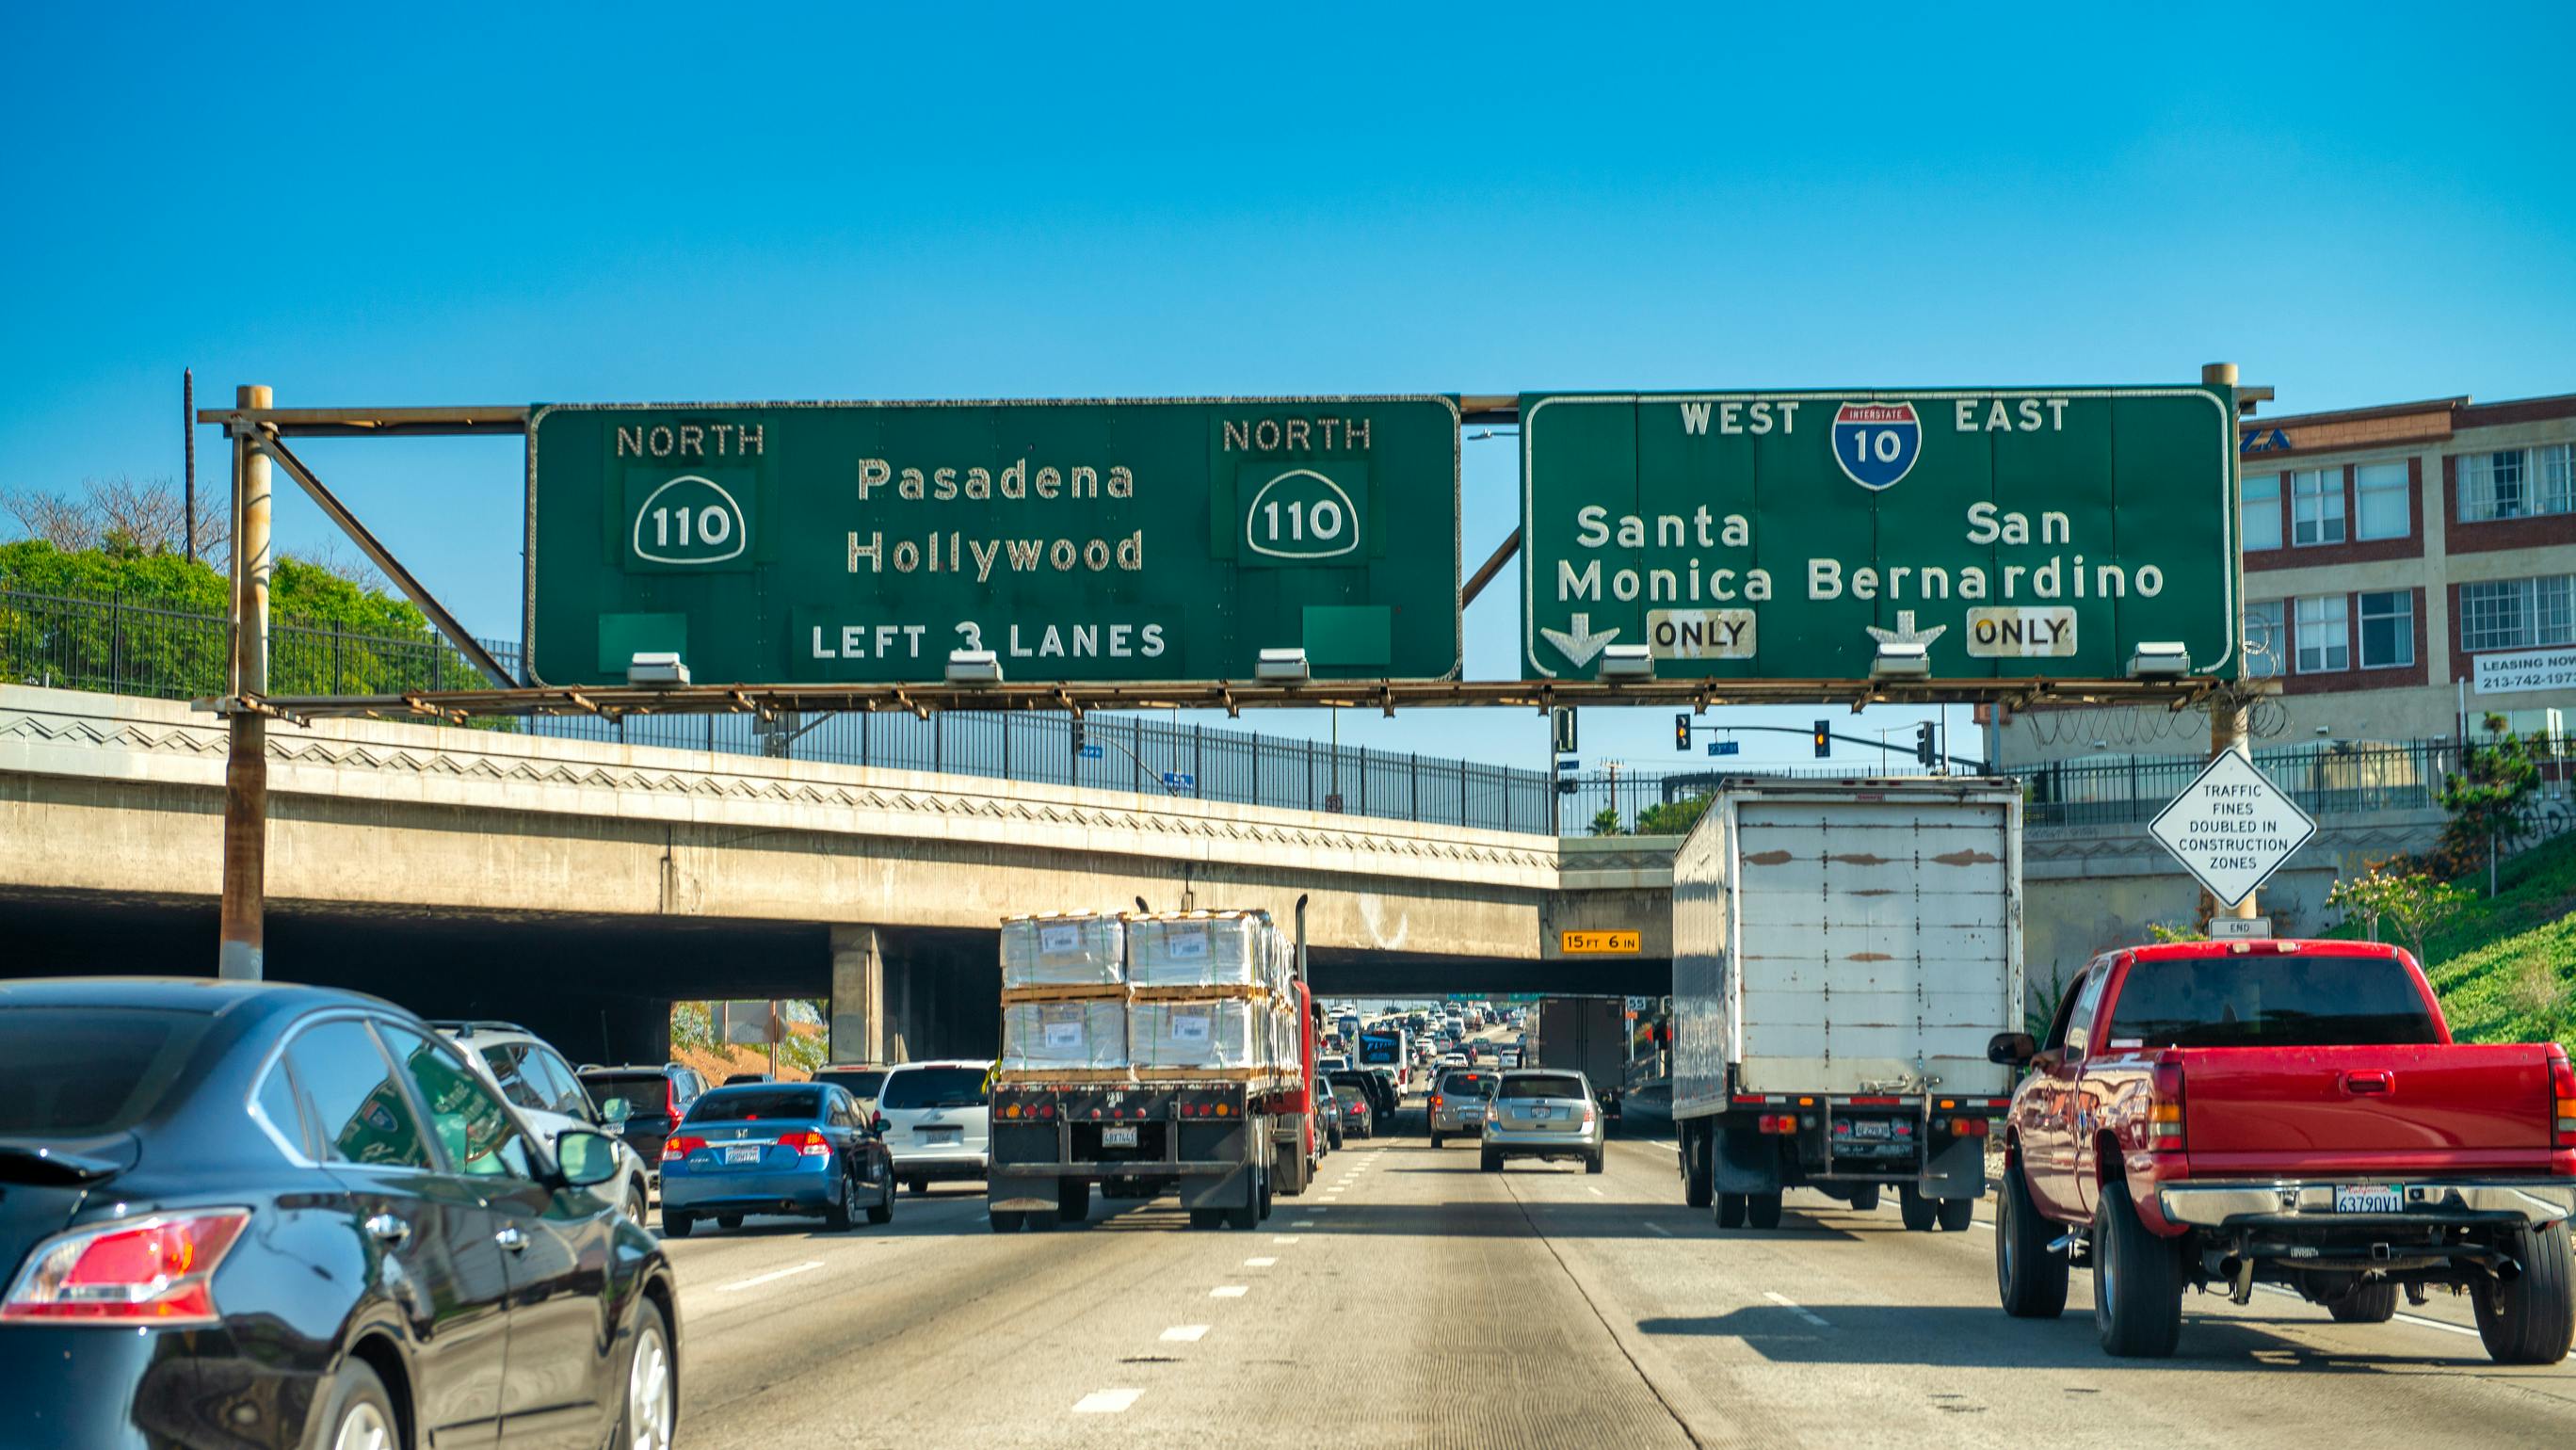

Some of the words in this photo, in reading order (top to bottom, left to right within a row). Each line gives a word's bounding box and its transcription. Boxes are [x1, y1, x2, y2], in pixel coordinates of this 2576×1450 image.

[1681, 402, 1799, 434] WEST
[1849, 409, 1902, 420] INTERSTATE
[1956, 399, 2069, 432] EAST
[617, 424, 764, 458] NORTH
[1224, 418, 1370, 451] NORTH
[1855, 429, 1901, 462] 10
[859, 458, 1133, 500] Pasadena
[652, 506, 731, 546] 110
[1264, 500, 1342, 541] 110
[1576, 504, 1748, 548] Santa
[1966, 501, 2069, 544] San
[847, 529, 1142, 583] Hollywood
[1558, 558, 1772, 602] Monica
[1808, 556, 2163, 600] Bernardino
[813, 625, 926, 659] LEFT
[955, 621, 983, 652] 3
[1009, 623, 1165, 658] LANES
[1655, 620, 1747, 647] ONLY
[1975, 618, 2069, 645] ONLY
[2483, 657, 2543, 671] LEASING
[2203, 784, 2262, 798] TRAFFIC
[2213, 803, 2254, 815] FINES
[2190, 820, 2257, 833] DOUBLED
[2262, 821, 2277, 833] IN
[2179, 839, 2288, 851] CONSTRUCTION
[2210, 857, 2257, 869] ZONES
[1568, 935, 1584, 948] 15
[1586, 939, 1599, 948] FT
[1608, 935, 1618, 948] 6
[1624, 939, 1634, 948] IN
[2230, 922, 2250, 933] END
[1629, 998, 1644, 1008] 55
[2348, 1184, 2390, 1195] California
[2339, 1195, 2399, 1214] 63790V1
